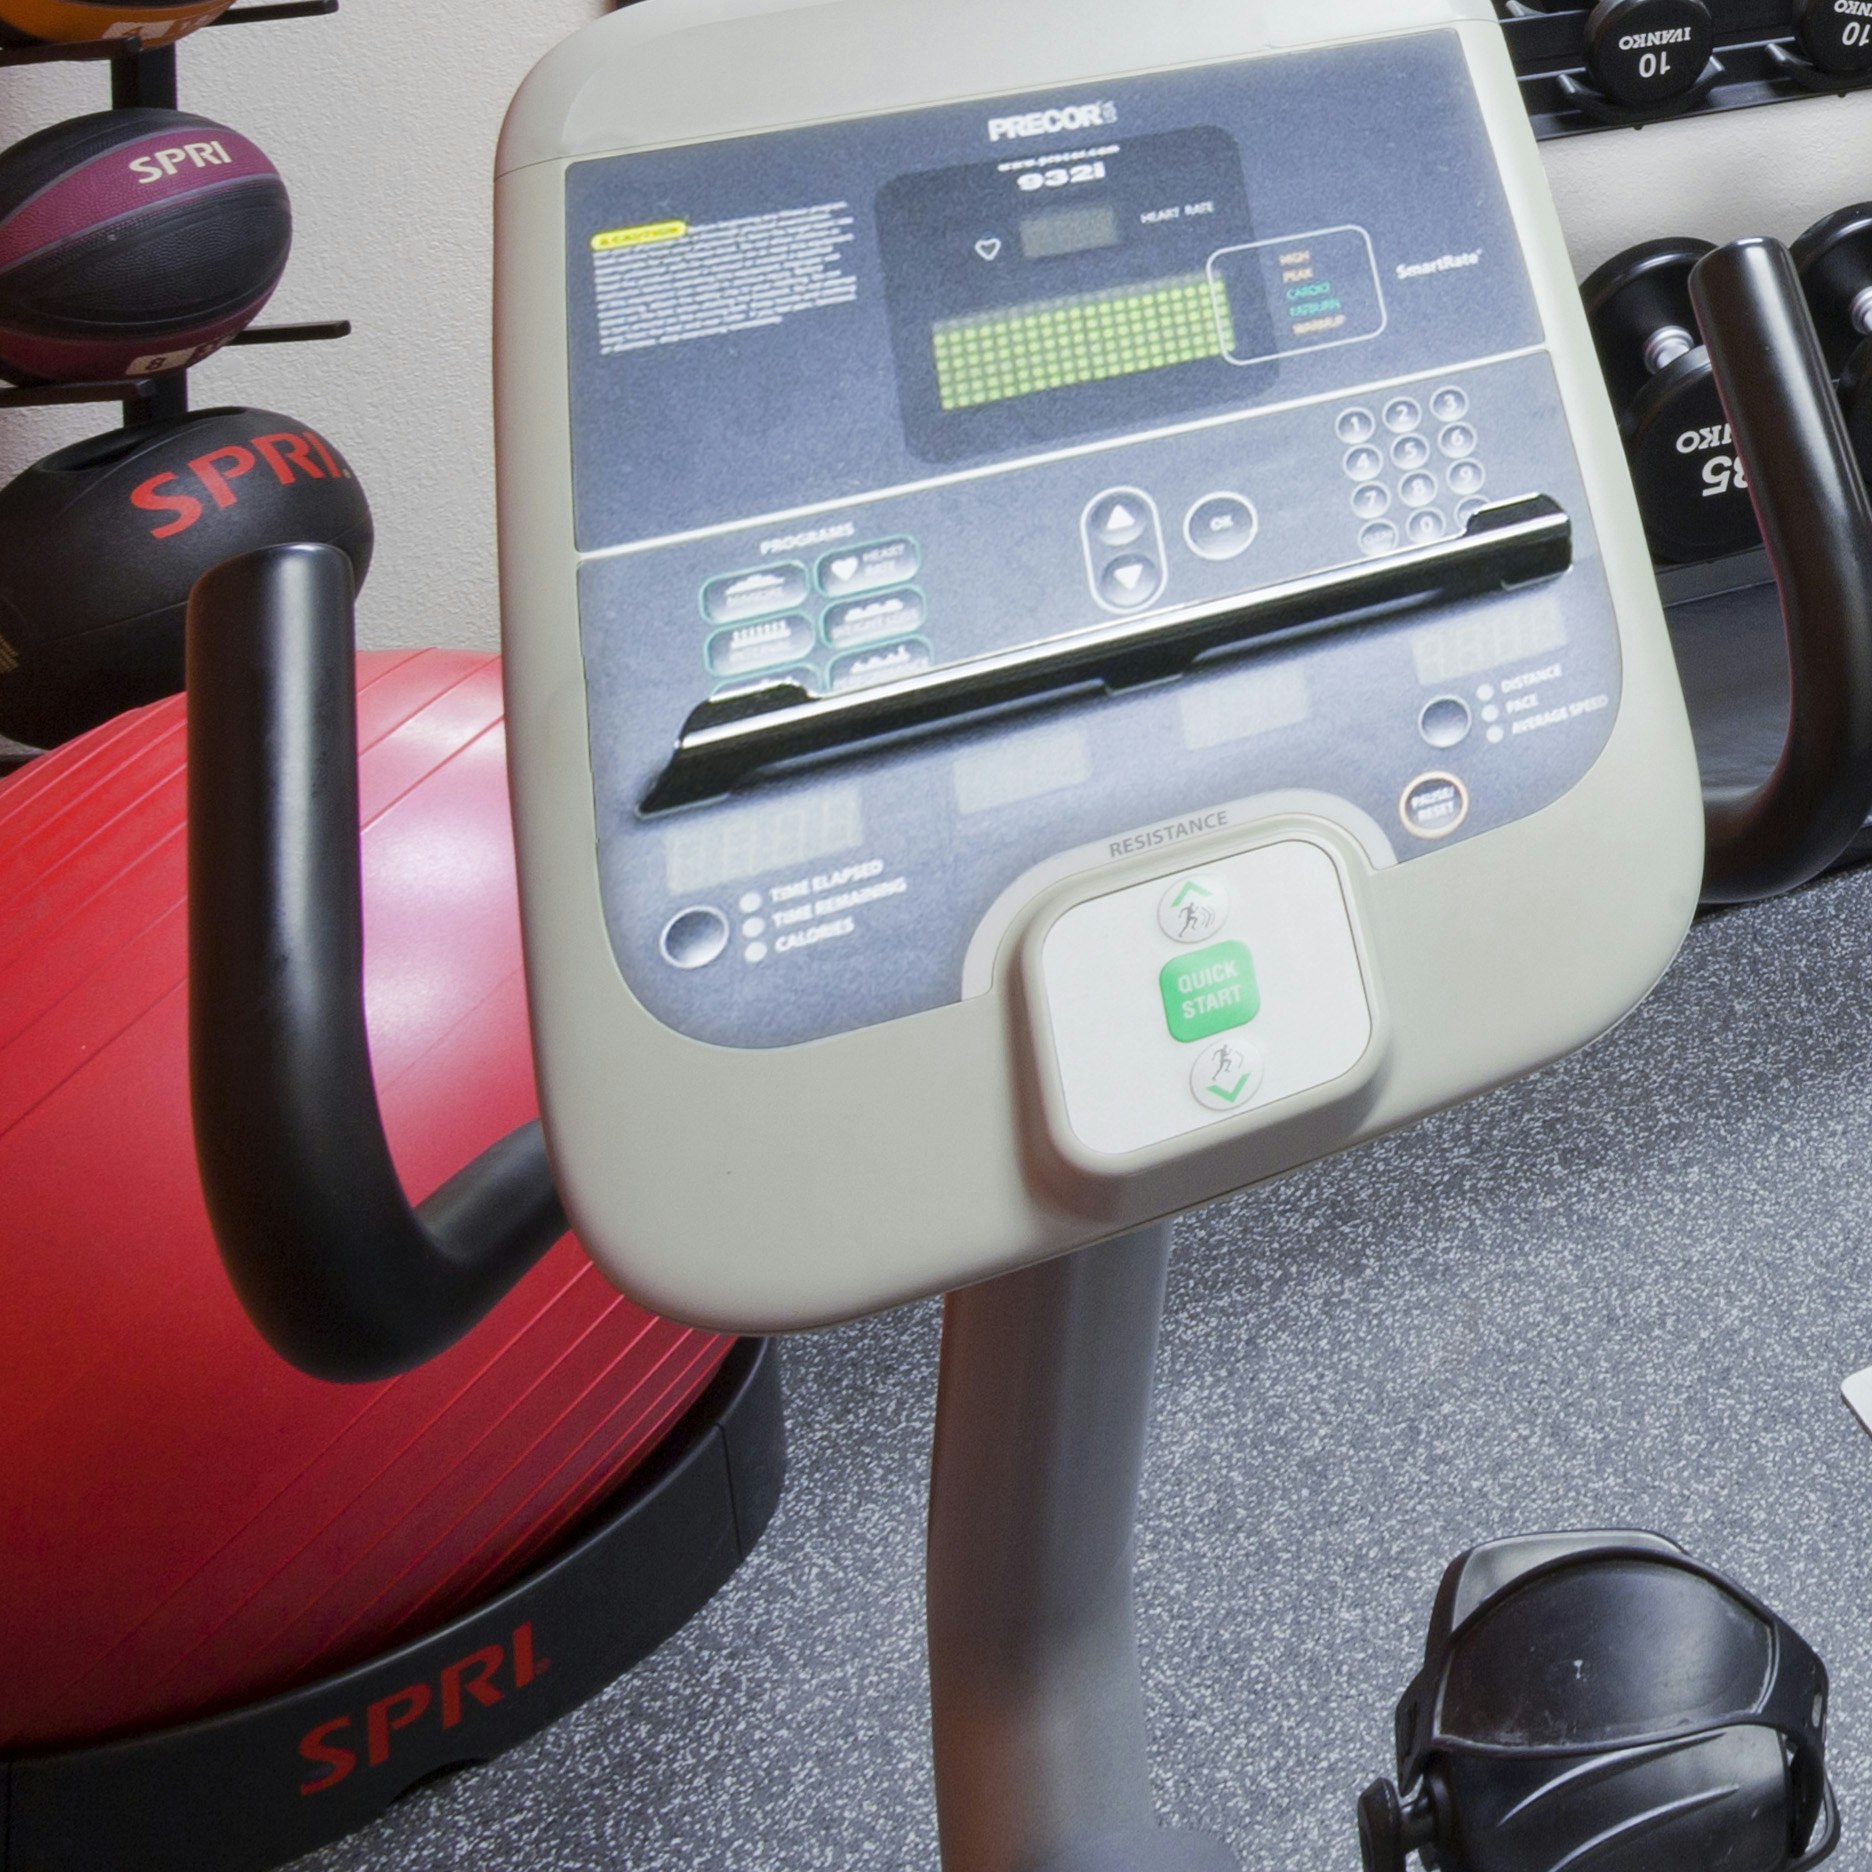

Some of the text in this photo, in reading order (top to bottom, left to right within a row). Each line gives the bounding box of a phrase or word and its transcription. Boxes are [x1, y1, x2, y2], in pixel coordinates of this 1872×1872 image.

[1619, 27, 1691, 51] IVANKO
[1841, 22, 1871, 46] 10
[1639, 51, 1670, 78] 10
[988, 103, 1103, 141] PRECOR
[129, 140, 232, 184] SPRI
[1140, 206, 1180, 224] HEART
[1396, 251, 1479, 279] SmartRate
[1397, 405, 1409, 421] 2
[1444, 394, 1455, 410] 3
[1452, 429, 1464, 445] 6
[1356, 452, 1369, 469] 4
[1404, 442, 1416, 459] 5
[130, 431, 341, 540] SPRI
[1413, 479, 1425, 496] 8
[1459, 467, 1472, 484] 9
[1365, 491, 1377, 508] 7
[1210, 515, 1233, 530] OK
[1501, 663, 1562, 694] DISTANCE
[1505, 693, 1538, 714] PACE
[1109, 810, 1228, 858] RESISTANCE
[769, 858, 884, 903] TIME ELAPSED
[772, 876, 907, 927] TIME REMAINING
[775, 916, 855, 953] CALORIES
[1178, 959, 1238, 994] QUICK
[1182, 984, 1241, 1019] START
[300, 1621, 536, 1796] SPRI
